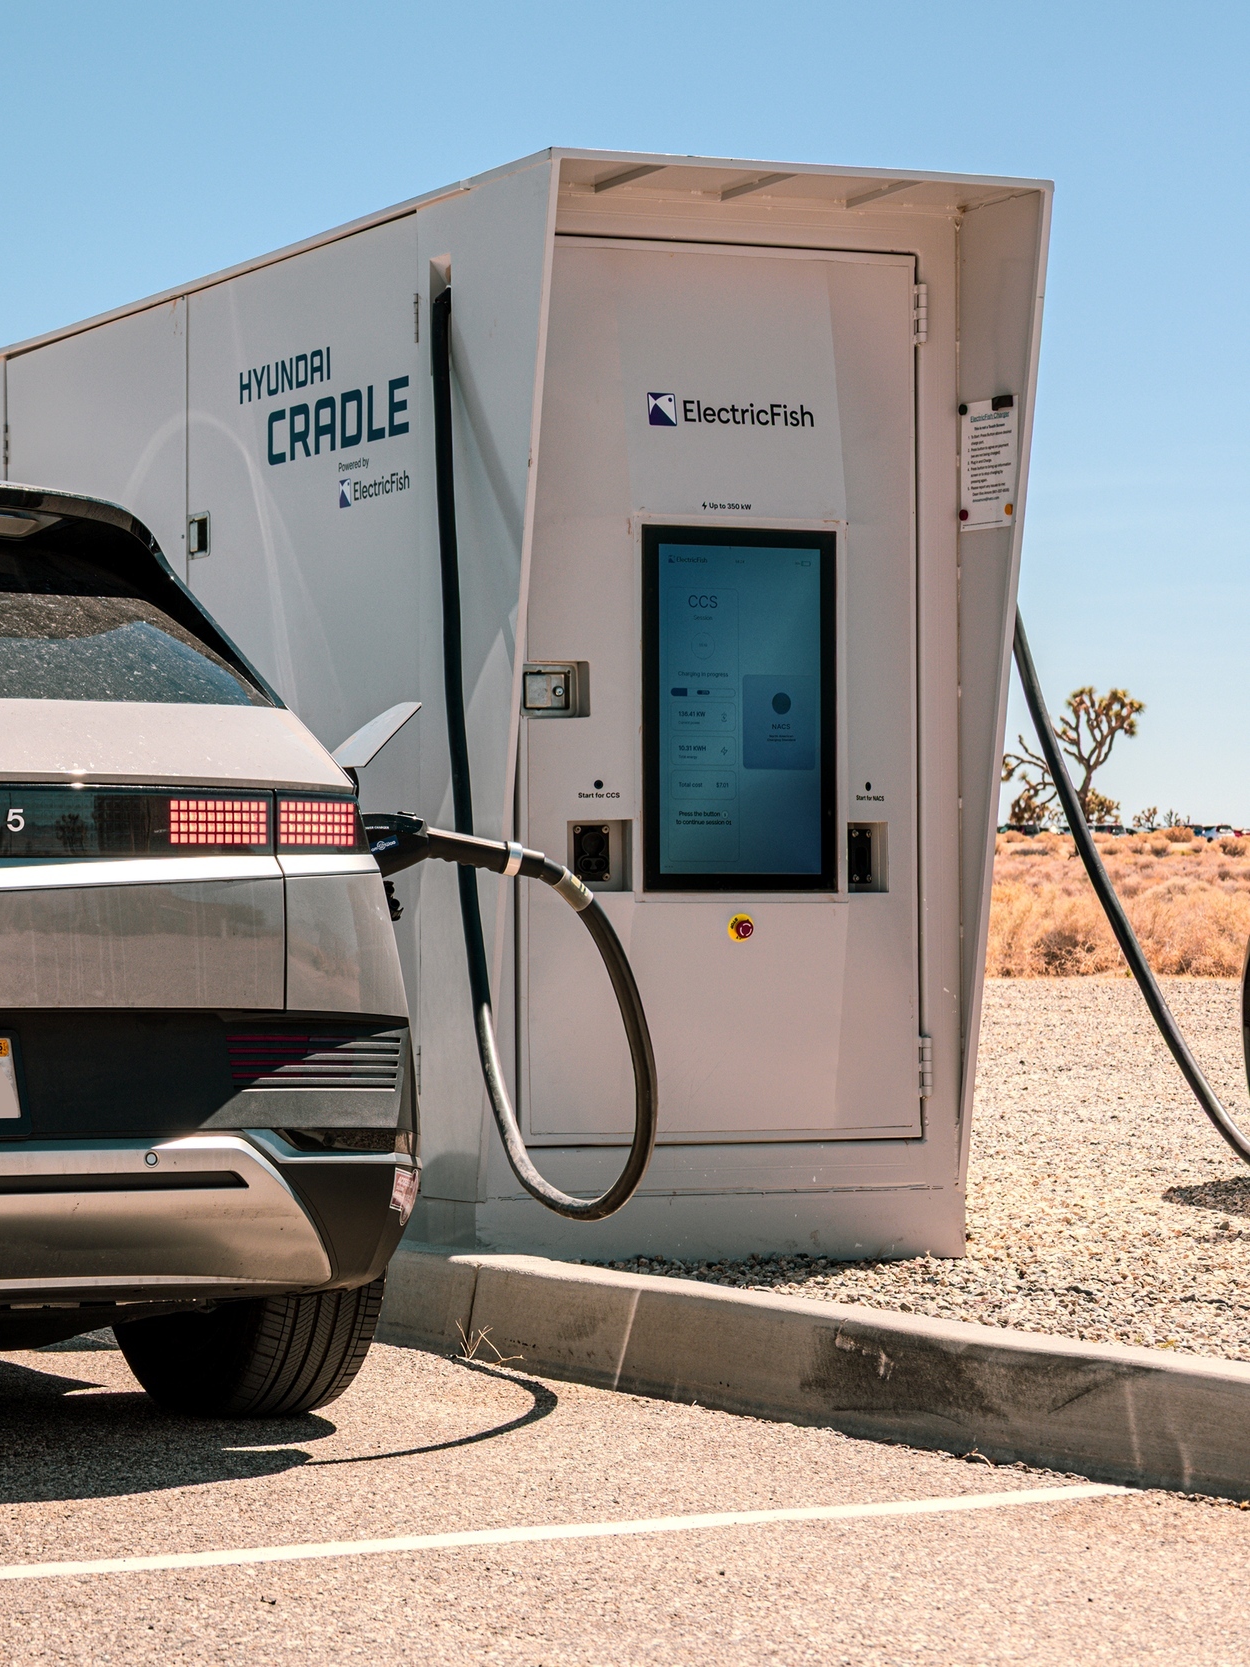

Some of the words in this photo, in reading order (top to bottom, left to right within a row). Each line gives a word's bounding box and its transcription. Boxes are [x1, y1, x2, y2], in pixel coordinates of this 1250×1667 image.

[239, 346, 331, 405] HYUNDAI
[267, 374, 410, 466] CRADLE
[682, 399, 815, 428] ElectricFish
[338, 457, 362, 473] Powered
[362, 457, 370, 469] by
[353, 469, 410, 502] ElectricFish
[708, 502, 718, 510] Up
[727, 502, 740, 510] 350
[676, 556, 708, 564] ElectricFish
[688, 594, 719, 609] CCS
[677, 670, 701, 678] Charging
[577, 791, 595, 799] Start
[595, 791, 605, 799] for
[605, 791, 621, 799] CCS
